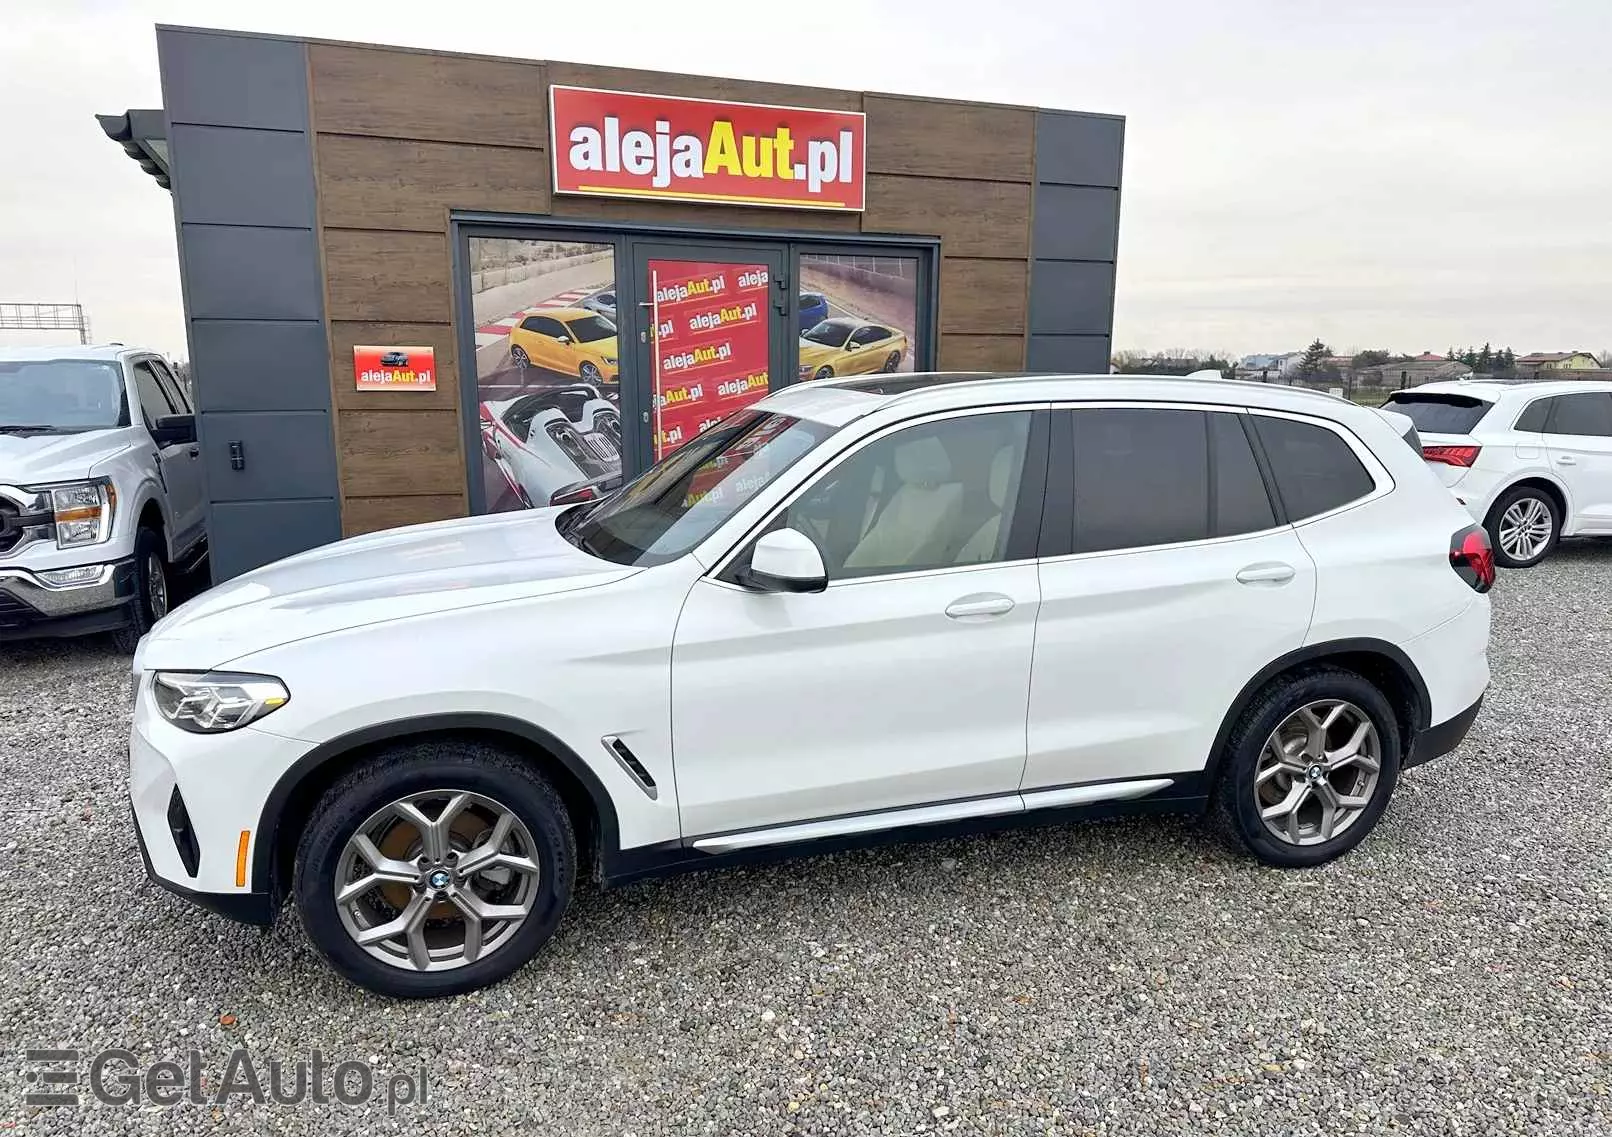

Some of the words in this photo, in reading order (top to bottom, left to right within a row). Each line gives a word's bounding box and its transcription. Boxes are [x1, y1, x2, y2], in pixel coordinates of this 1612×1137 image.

[569, 116, 853, 192] alejaAut.pl
[657, 275, 725, 303] alejaAut.pl
[689, 303, 757, 330] alejaAut.pl
[663, 342, 731, 370] alejaAut.pl
[361, 369, 431, 384] alejaAut.pl
